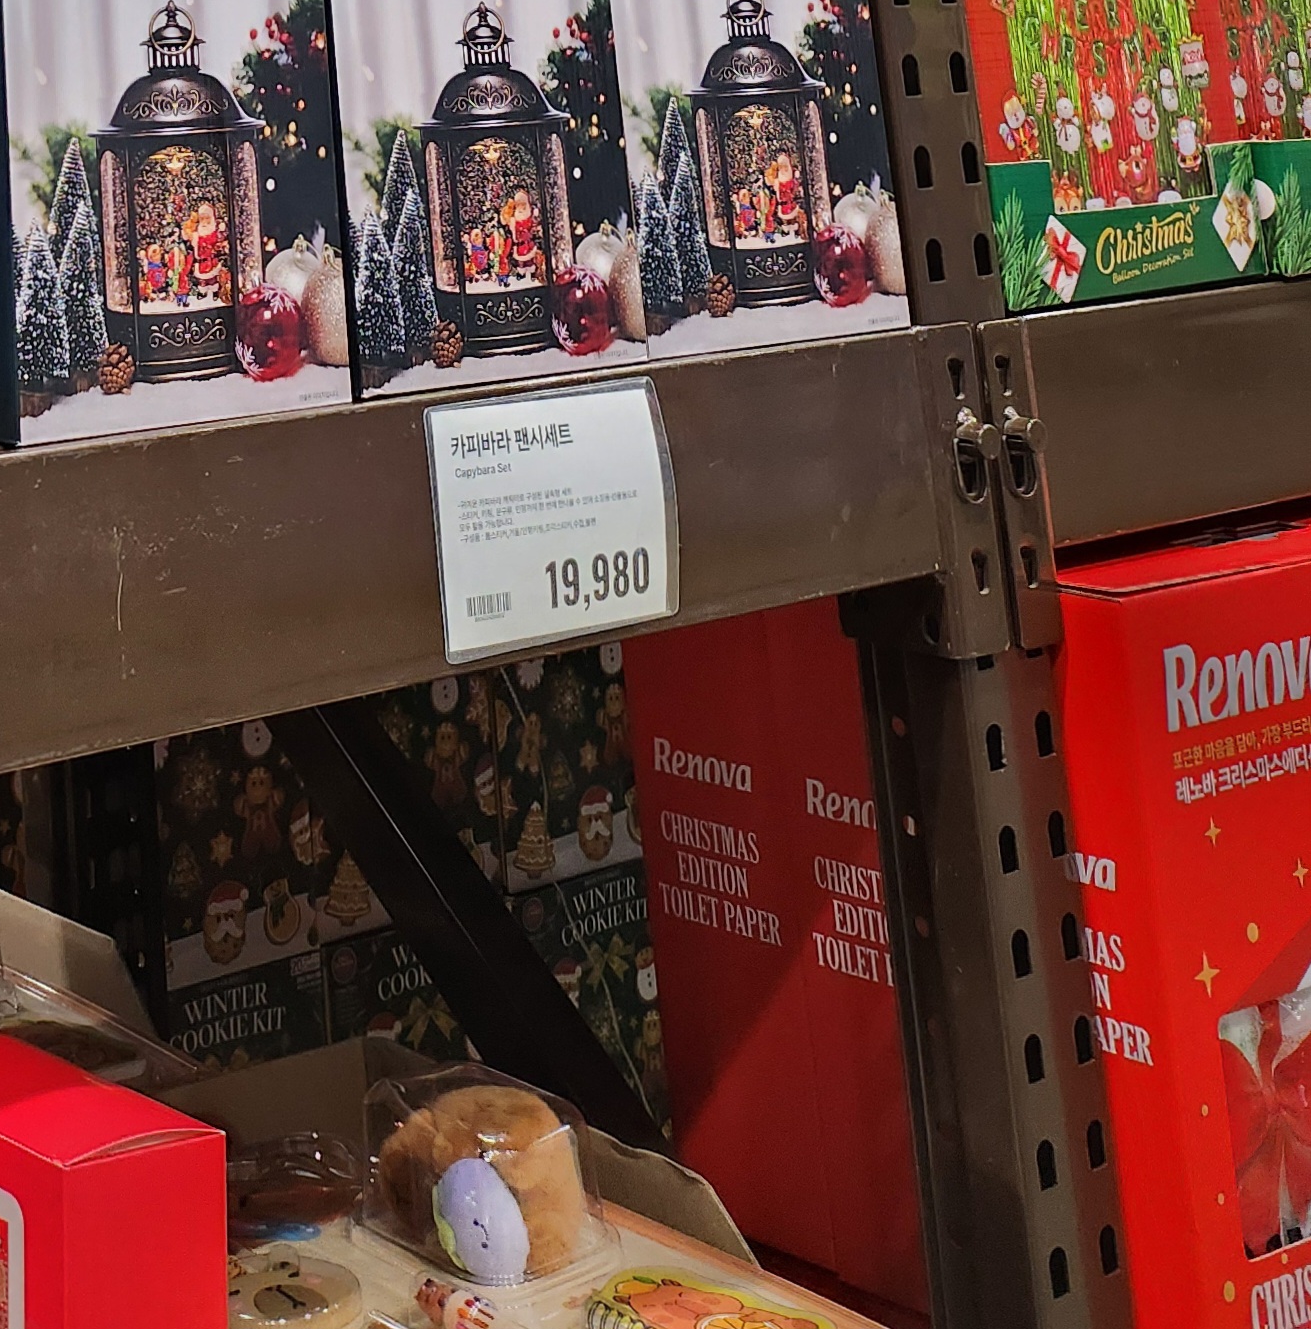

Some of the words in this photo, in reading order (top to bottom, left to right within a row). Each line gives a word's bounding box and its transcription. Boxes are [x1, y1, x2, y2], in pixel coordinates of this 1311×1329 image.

[1096, 211, 1194, 275] Christmas
[1113, 268, 1141, 284] Balloon
[451, 430, 511, 459] 카피바라
[514, 423, 573, 452] 팬시세트
[455, 464, 496, 479] Capybara
[497, 462, 512, 474] Set
[545, 547, 649, 611] 19,980
[1163, 636, 1311, 732] Renov
[654, 737, 752, 793] Renova
[1173, 749, 1203, 770] 포근한
[1205, 739, 1235, 761] 마음을
[1236, 732, 1261, 754] 담아,
[1261, 724, 1281, 745] 가장
[806, 778, 878, 831] Reno
[1175, 767, 1217, 804] 레노바
[661, 810, 759, 864] CHRISTMAS
[572, 876, 637, 915] WINTER
[677, 851, 749, 899] EDITION
[814, 856, 885, 904] CHRIST
[561, 904, 624, 948] COOKIE
[625, 898, 648, 923] KIT
[658, 882, 719, 929] TOILET
[723, 900, 782, 947] PAPER
[833, 898, 889, 944] EDITI
[812, 932, 879, 983] TOILET
[183, 982, 269, 1026] WINTER
[377, 964, 434, 1002] COOK
[170, 1014, 250, 1054] COOKIE
[253, 1006, 287, 1035] KIT
[1095, 1014, 1155, 1067] APER
[1251, 1263, 1311, 1329] CHRIS
